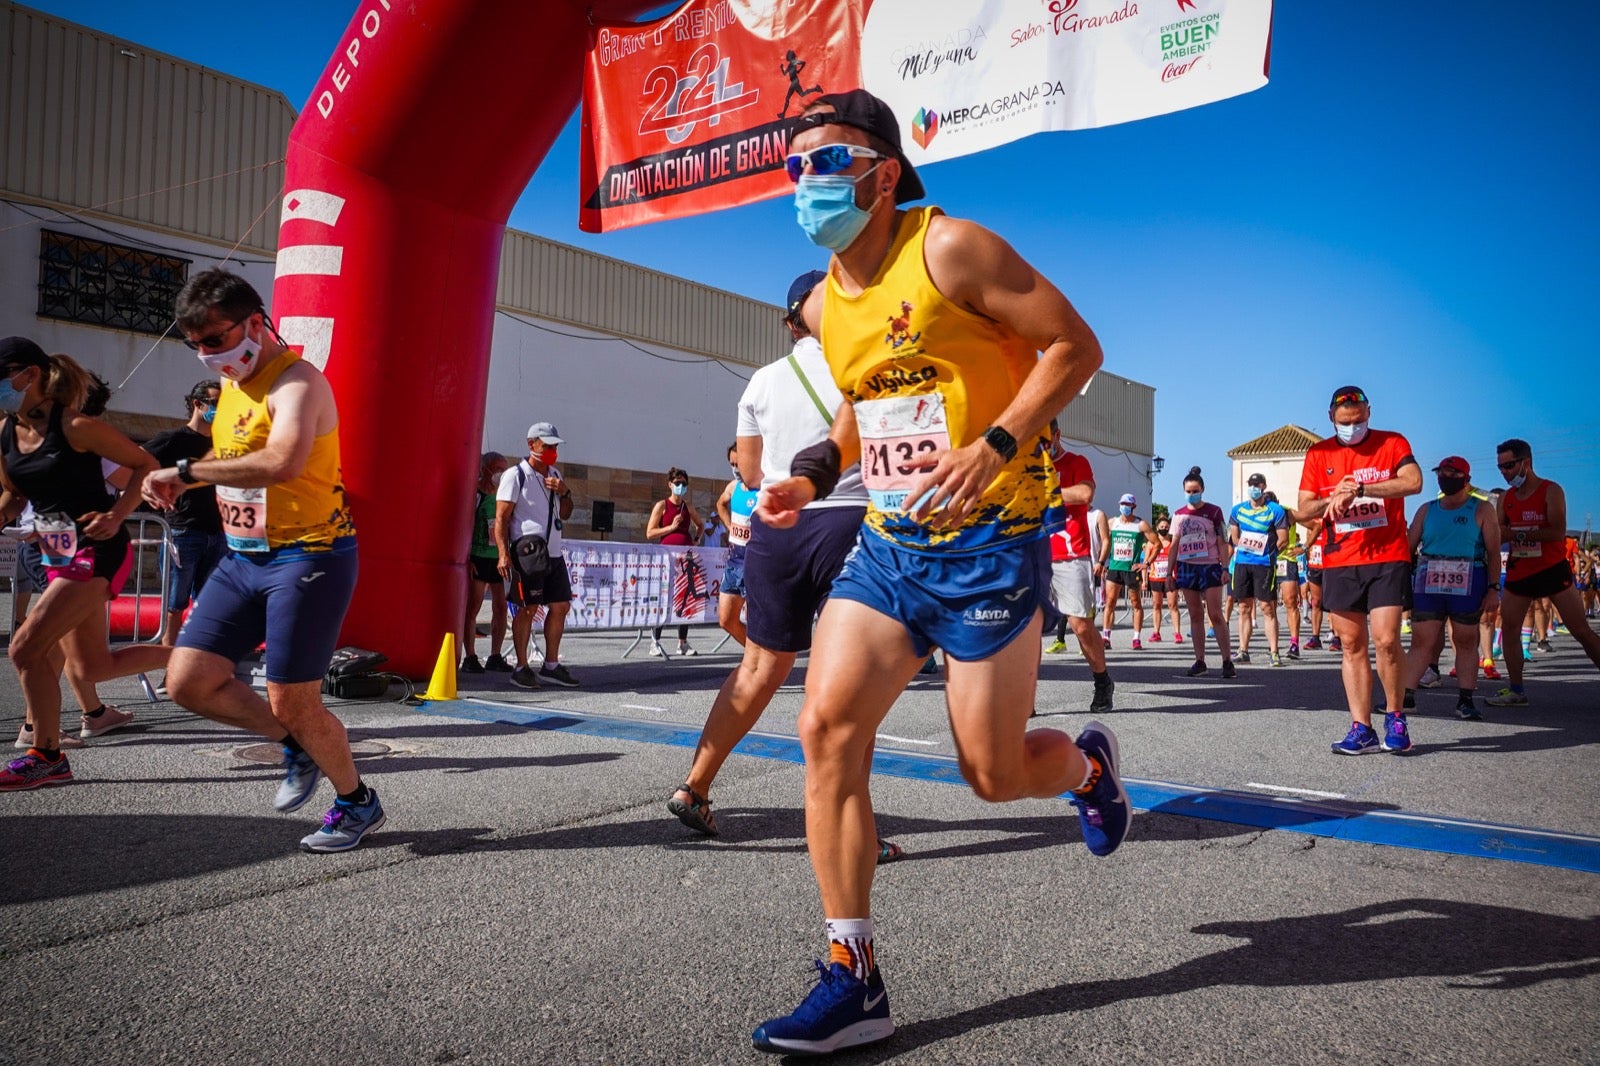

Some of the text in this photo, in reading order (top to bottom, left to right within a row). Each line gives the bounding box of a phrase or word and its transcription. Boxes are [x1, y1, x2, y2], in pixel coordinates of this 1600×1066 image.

[1062, 1, 1139, 33] Granada
[1160, 13, 1220, 34] EVENTOS CON
[1161, 22, 1220, 50] BUEN
[898, 50, 934, 80] Mil
[940, 81, 1065, 128] MERCAGRANADA
[609, 149, 705, 202] DIPUTACIÓN
[709, 144, 732, 179] DE
[865, 365, 938, 393] Vigilsa
[219, 500, 256, 529] 023
[1343, 502, 1379, 519] 2150
[732, 526, 750, 539] 1038
[1243, 538, 1263, 549] 2179
[1182, 542, 1204, 552] 2180
[1433, 574, 1463, 584] 2139
